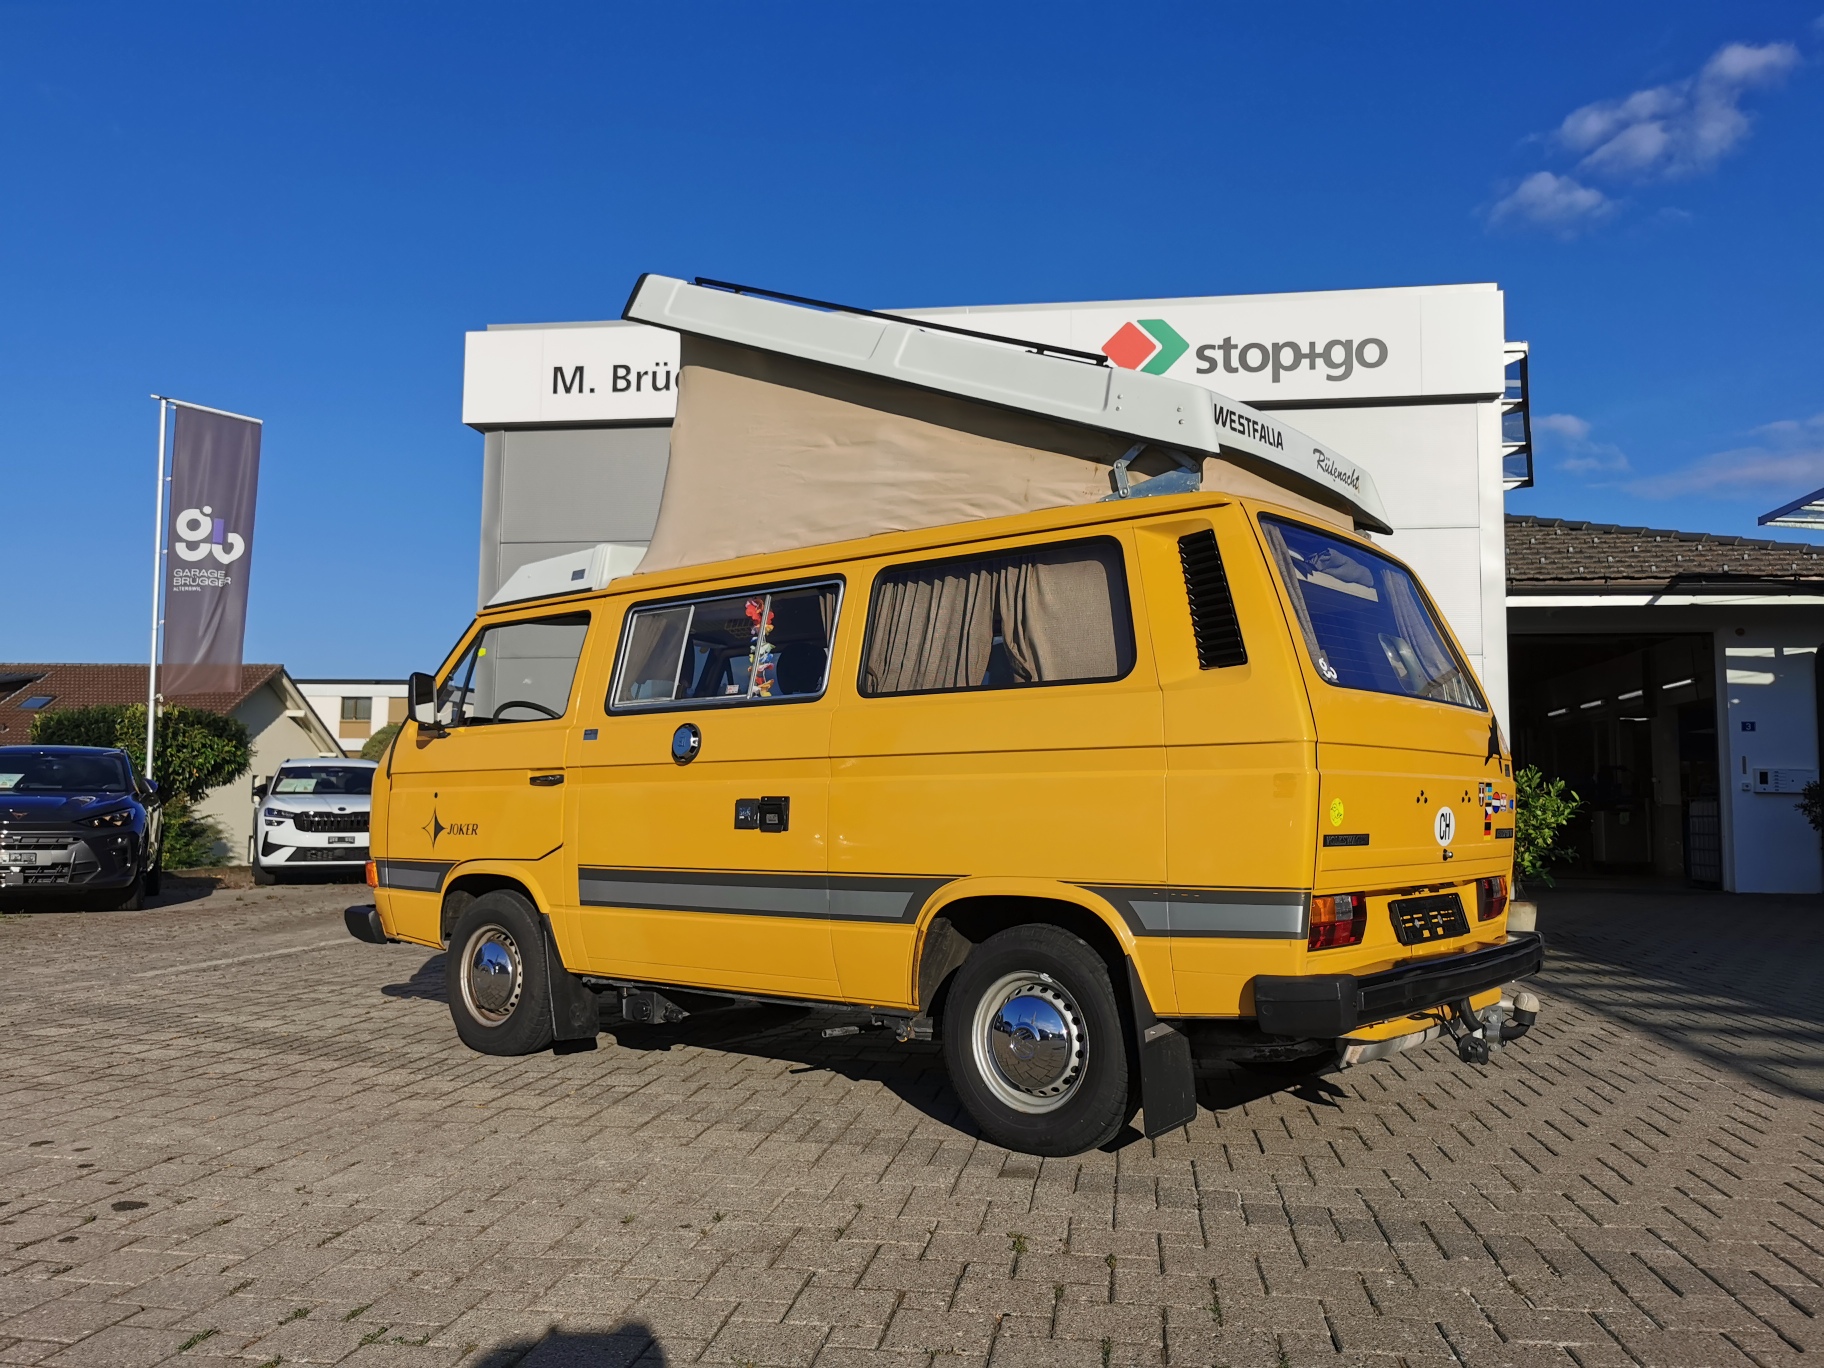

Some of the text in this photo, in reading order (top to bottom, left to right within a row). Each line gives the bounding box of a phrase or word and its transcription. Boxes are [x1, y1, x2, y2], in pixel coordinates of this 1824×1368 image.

[1195, 336, 1388, 383] stop+go
[553, 362, 679, 394] M. Brü
[1213, 403, 1284, 451] WESTFALIA
[173, 568, 226, 579] GARAGE
[173, 575, 231, 587] BRÜGGER
[1745, 722, 1752, 731] 3
[446, 823, 479, 836] JOKER
[1439, 812, 1451, 841] CH
